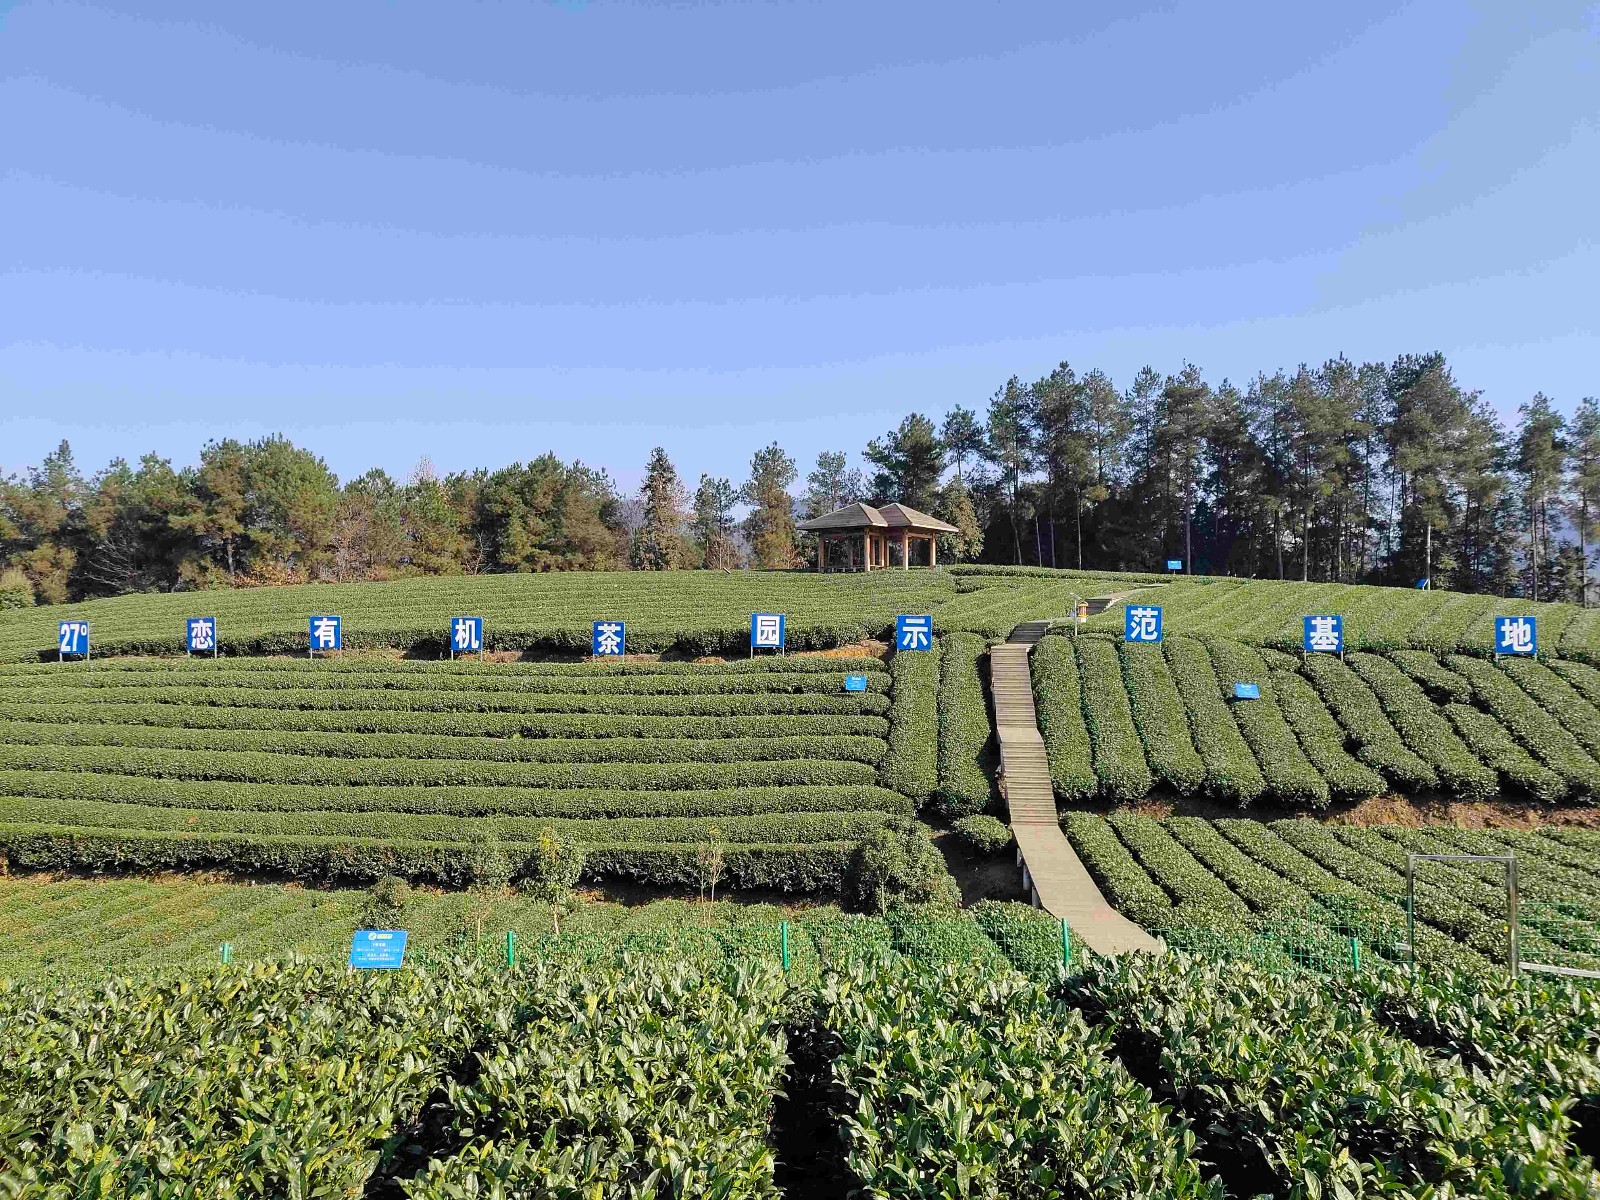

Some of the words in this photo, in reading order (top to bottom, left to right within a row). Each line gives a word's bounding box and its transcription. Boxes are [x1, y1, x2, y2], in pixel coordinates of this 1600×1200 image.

[191, 620, 214, 649] 恋
[314, 619, 338, 648] 有
[455, 619, 479, 649] 机
[597, 624, 621, 653] 茶
[756, 616, 780, 646] 园
[903, 618, 928, 648] 示
[1130, 608, 1159, 640] 范
[1310, 617, 1338, 650] 基
[1501, 619, 1533, 651] 地
